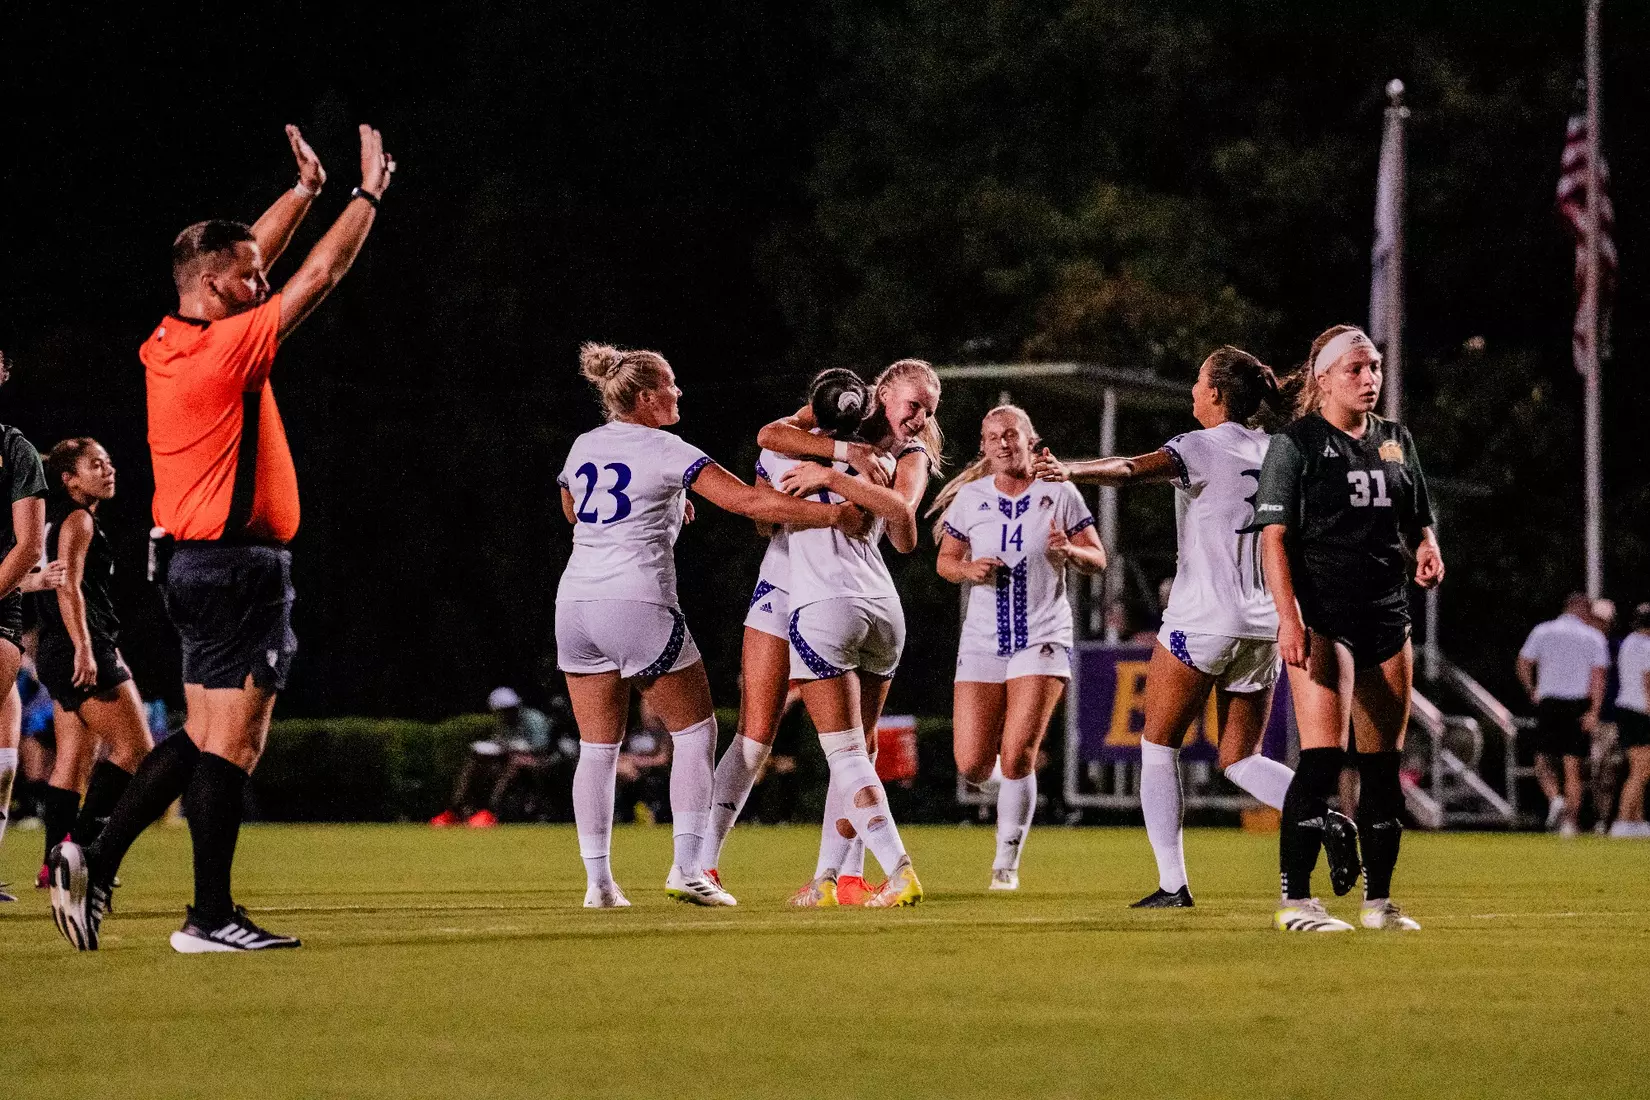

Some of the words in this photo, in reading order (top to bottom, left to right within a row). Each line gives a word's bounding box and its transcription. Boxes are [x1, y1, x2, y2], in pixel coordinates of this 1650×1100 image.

[575, 462, 632, 524] 23
[1347, 470, 1392, 507] 31
[1001, 523, 1024, 552] 14
